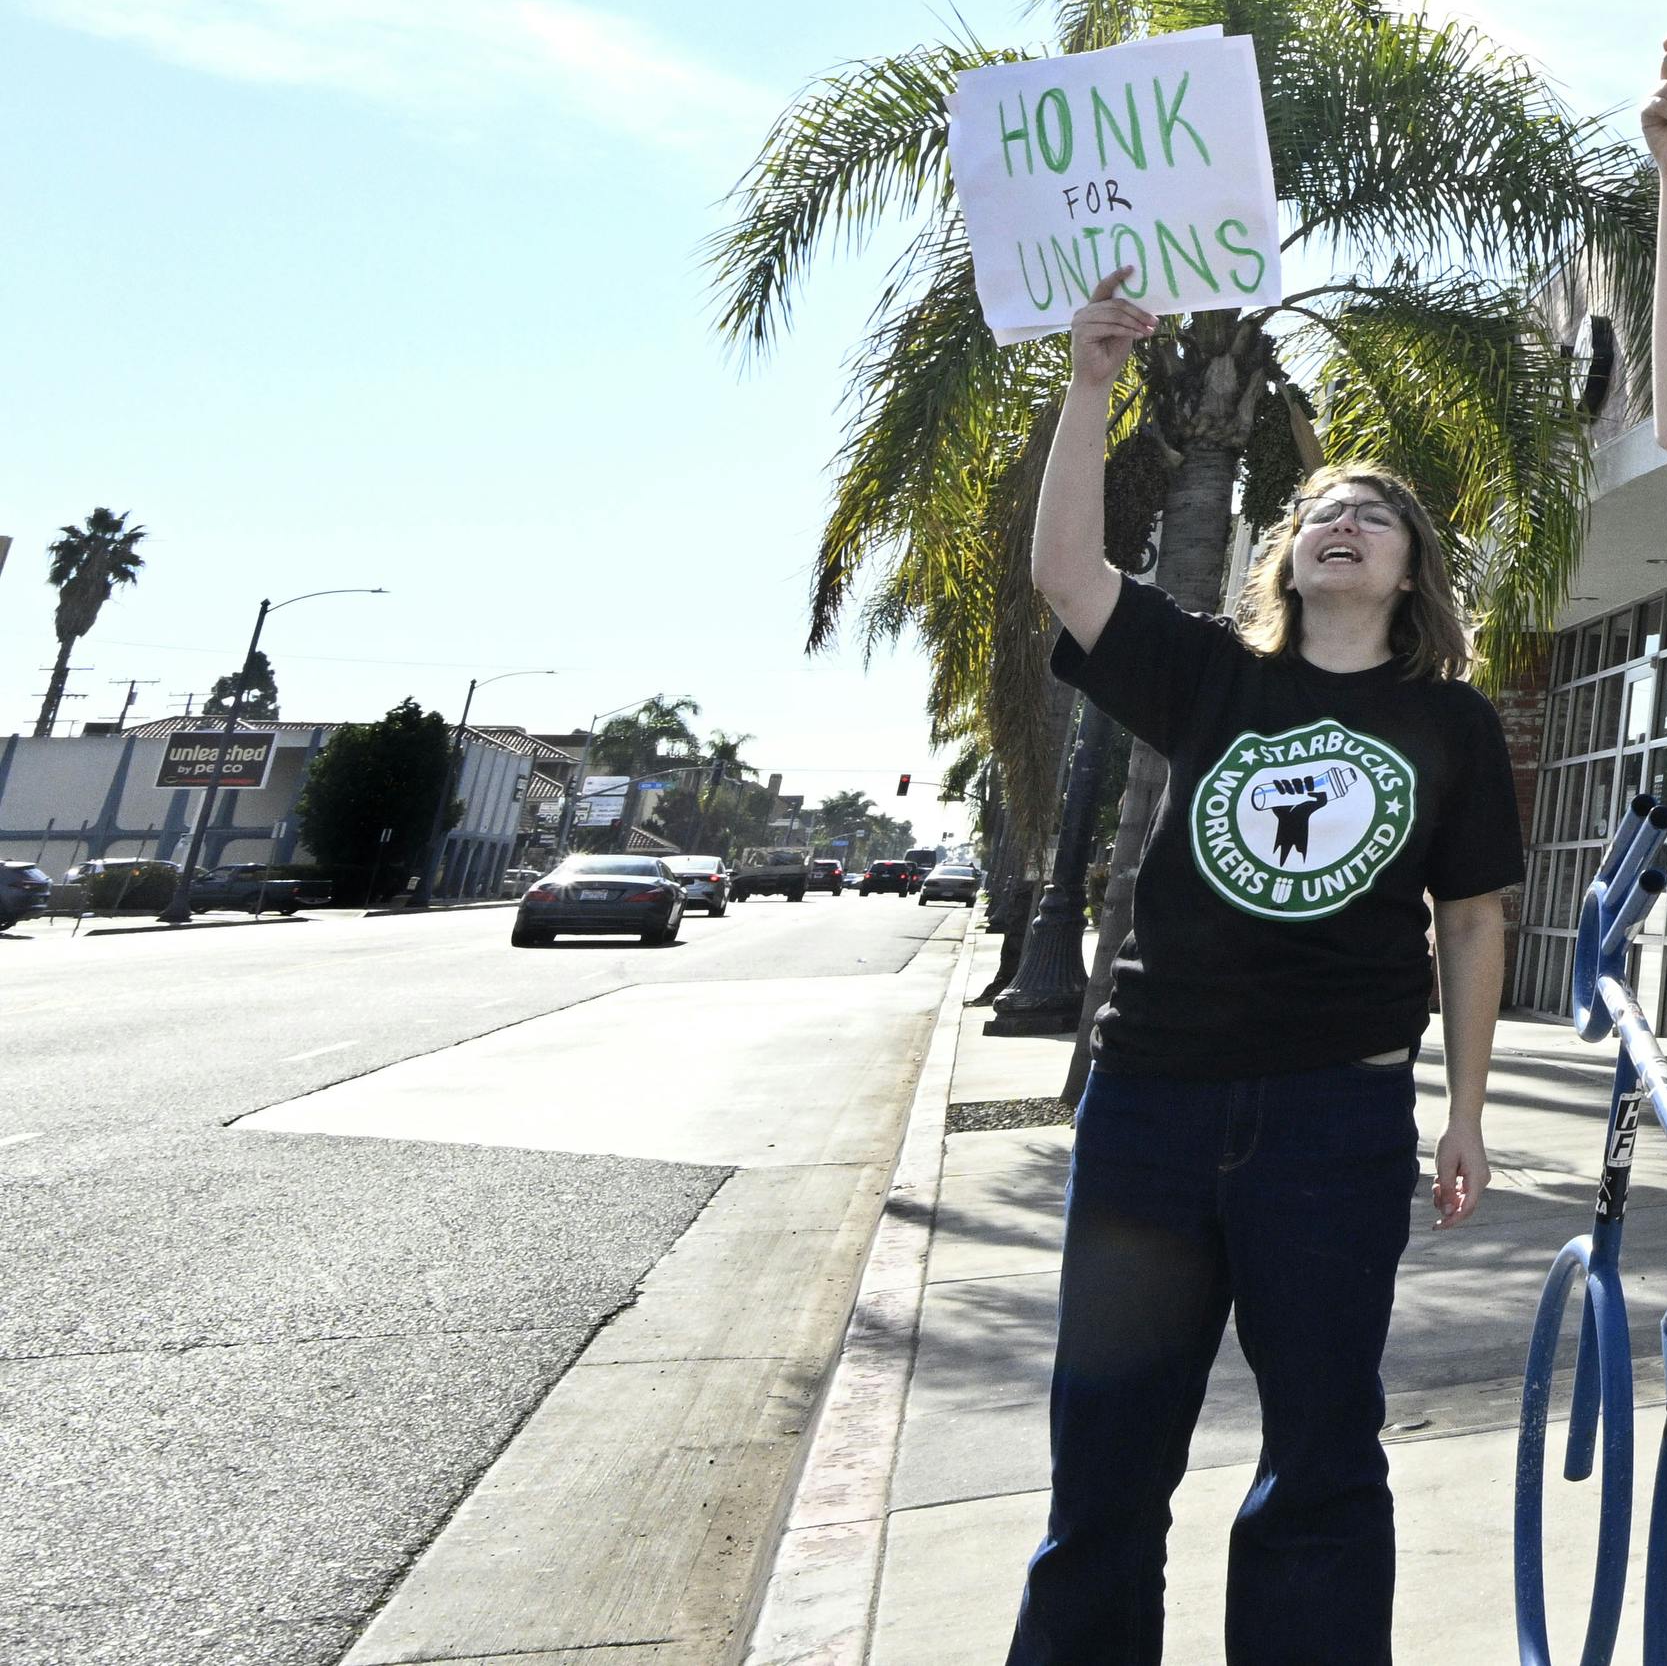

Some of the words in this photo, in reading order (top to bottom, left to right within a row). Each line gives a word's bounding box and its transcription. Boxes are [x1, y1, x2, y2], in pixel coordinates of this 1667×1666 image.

[998, 71, 1211, 177] HONK
[1062, 179, 1132, 219] FOR
[1017, 218, 1265, 311] UNIONS
[177, 765, 192, 775] by
[194, 764, 243, 775] peco
[1259, 731, 1403, 791] STARBUCKS
[1205, 769, 1269, 895] WORKERS
[1302, 823, 1396, 902] UNITED
